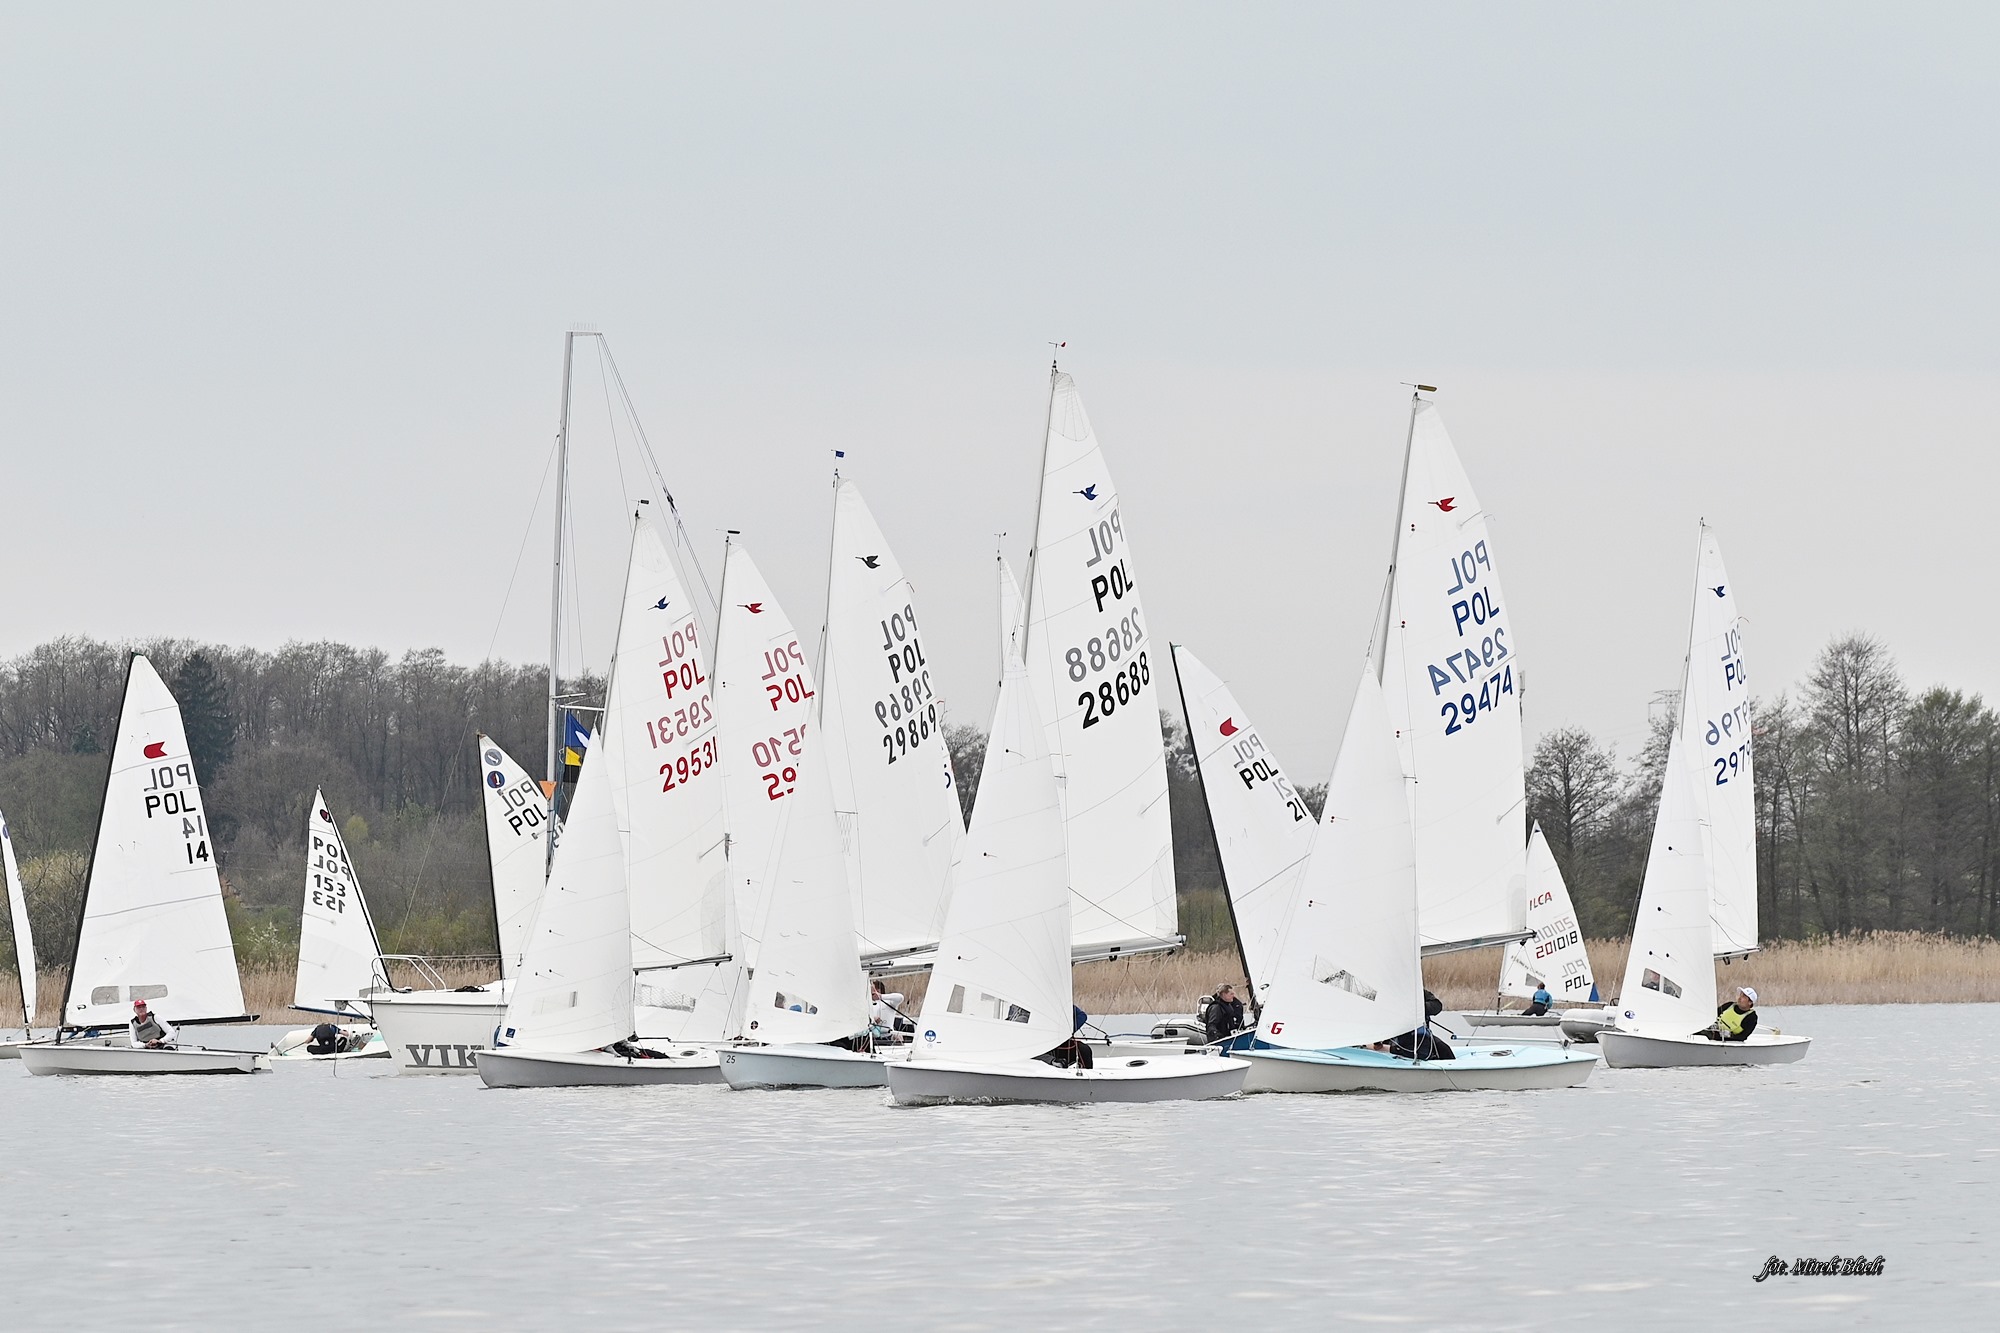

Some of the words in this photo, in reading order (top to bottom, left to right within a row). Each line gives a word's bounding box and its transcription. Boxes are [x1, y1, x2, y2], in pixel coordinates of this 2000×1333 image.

[1091, 558, 1134, 613] POL
[1452, 586, 1500, 637] POL
[888, 638, 926, 684] POL
[662, 658, 706, 700] POL
[765, 674, 815, 711] POL
[1077, 651, 1150, 730] 28688
[1441, 664, 1514, 736] 29474
[883, 703, 937, 765] 29869
[659, 736, 718, 793] 29531
[1239, 758, 1279, 790] POL
[145, 790, 197, 819] POL
[508, 804, 548, 836] POL
[1286, 797, 1307, 822] 21
[186, 840, 209, 864] 14
[313, 874, 346, 898] 153
[1529, 891, 1553, 911] ILCA
[1535, 931, 1578, 960] 201018
[1565, 974, 1591, 993] POL
[726, 1055, 736, 1064] 25
